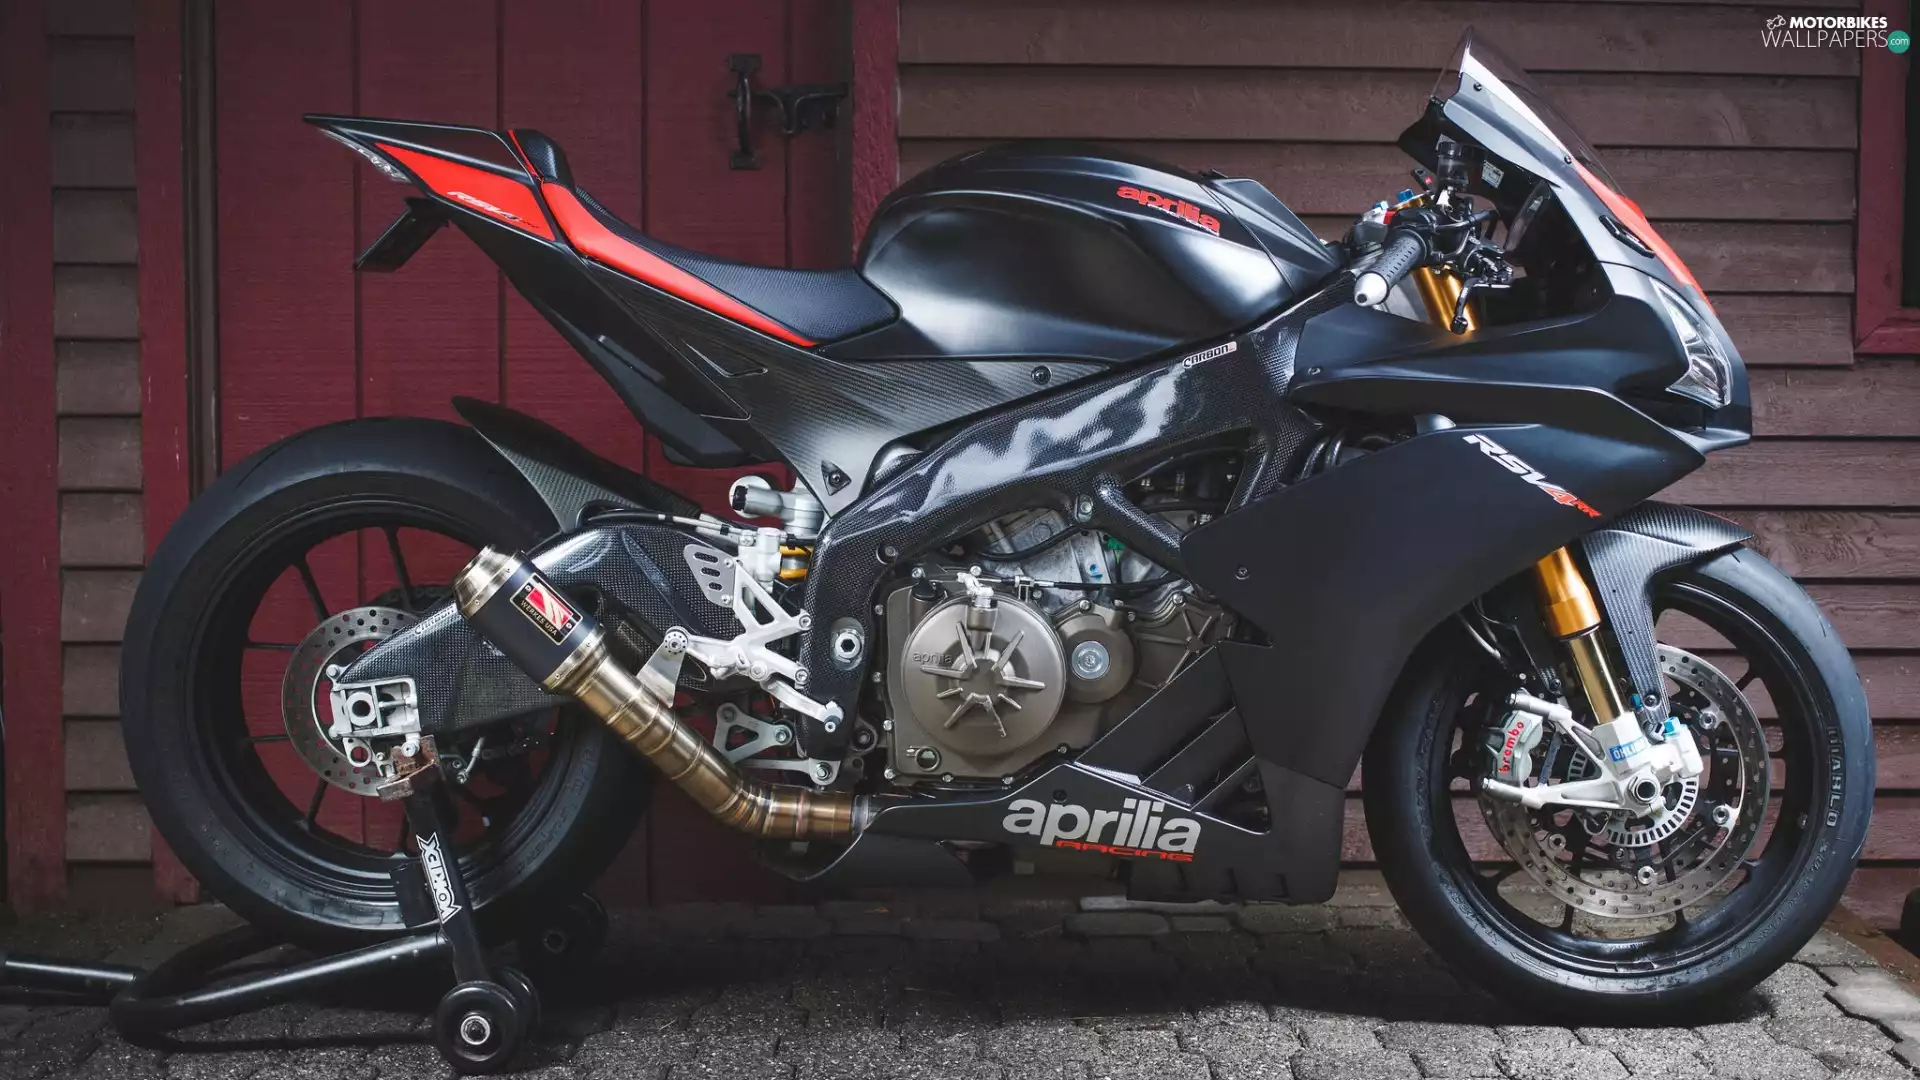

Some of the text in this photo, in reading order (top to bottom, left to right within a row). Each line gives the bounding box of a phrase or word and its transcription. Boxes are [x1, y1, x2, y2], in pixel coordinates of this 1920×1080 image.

[1116, 186, 1220, 233] aprilia
[521, 600, 558, 636] WERKES USA
[1499, 721, 1524, 773] brembo
[1002, 797, 1201, 853] aprilia
[1056, 840, 1193, 862] RACING
[418, 834, 459, 922] VORTEX
